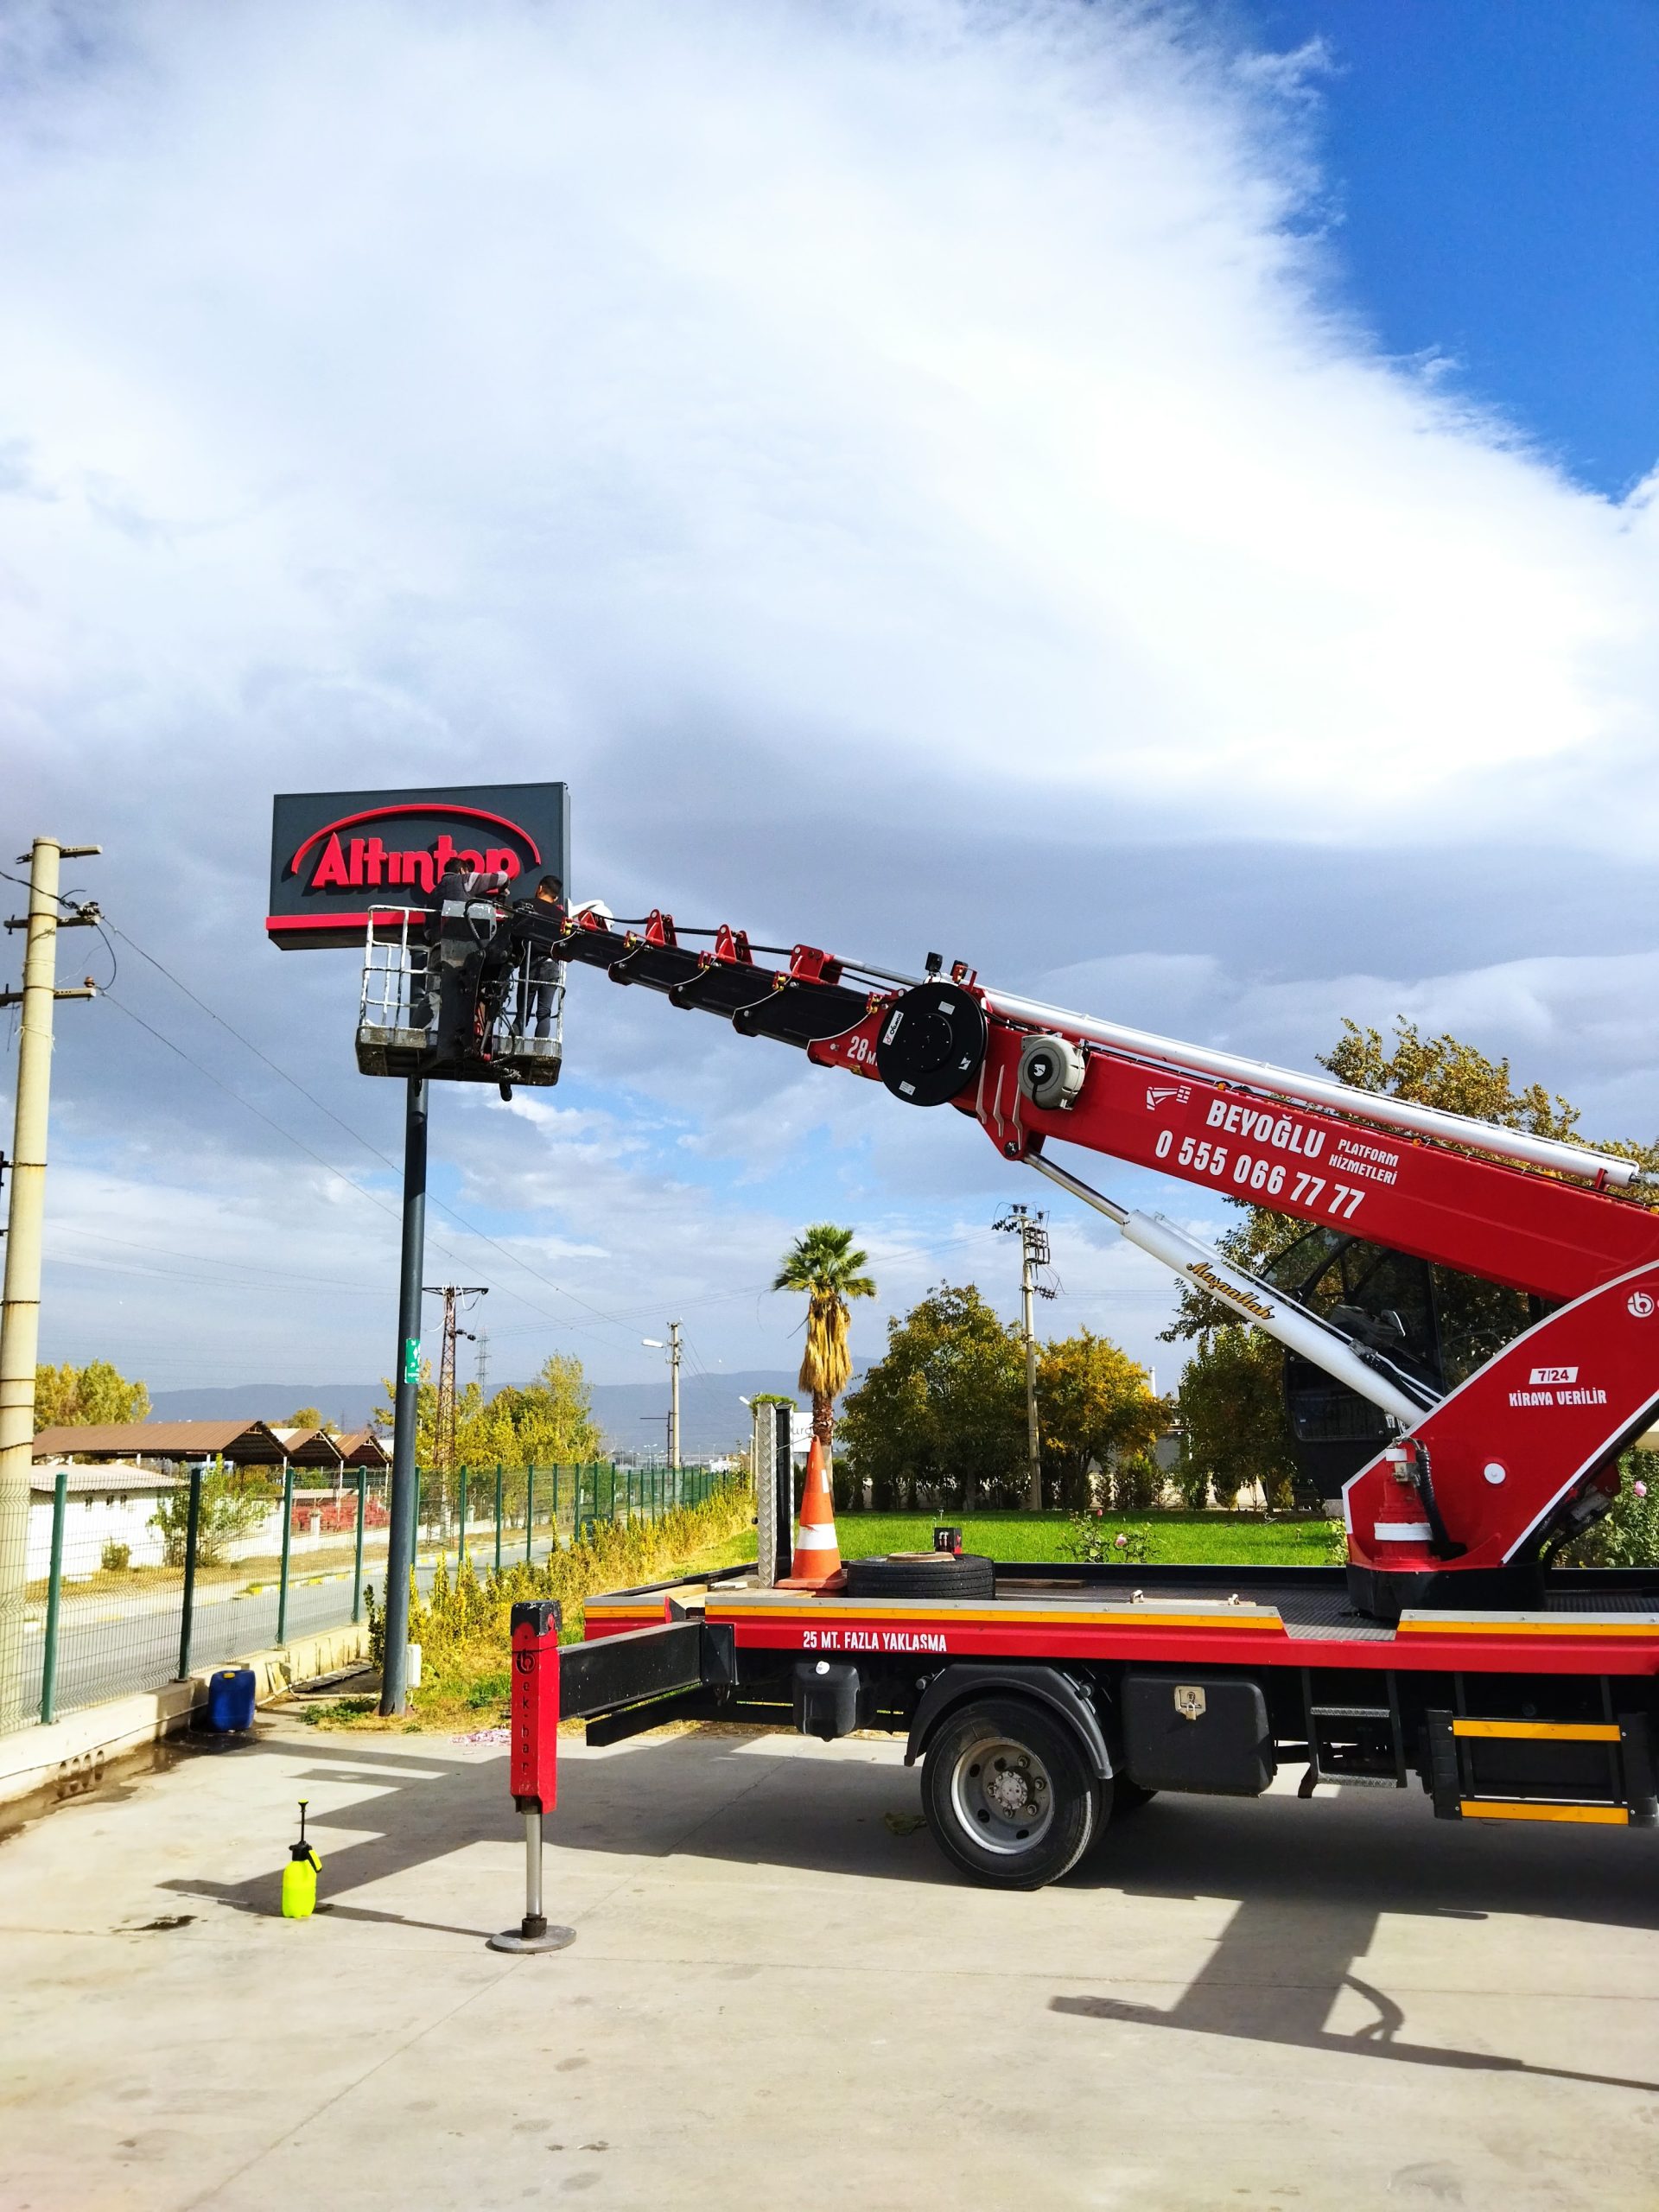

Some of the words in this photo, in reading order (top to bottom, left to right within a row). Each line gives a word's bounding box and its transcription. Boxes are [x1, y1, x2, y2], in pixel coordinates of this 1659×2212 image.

[847, 1035, 869, 1061] 28
[1206, 1099, 1326, 1159] BEYOĞLU
[1338, 1138, 1400, 1167] PLATFORM
[1154, 1129, 1173, 1159] 0
[1178, 1136, 1228, 1176] 555
[1233, 1154, 1287, 1195] 066
[1289, 1172, 1327, 1207] 77
[1327, 1183, 1365, 1219] 77
[1328, 1154, 1398, 1185] HİZMETLERİ
[1538, 1370, 1569, 1382] 7/24
[1509, 1389, 1554, 1407] KİRAYA
[1556, 1387, 1607, 1405] VERİLİR
[803, 1630, 817, 1648] 25
[821, 1630, 841, 1649] MT.
[844, 1631, 880, 1649] FAZLA
